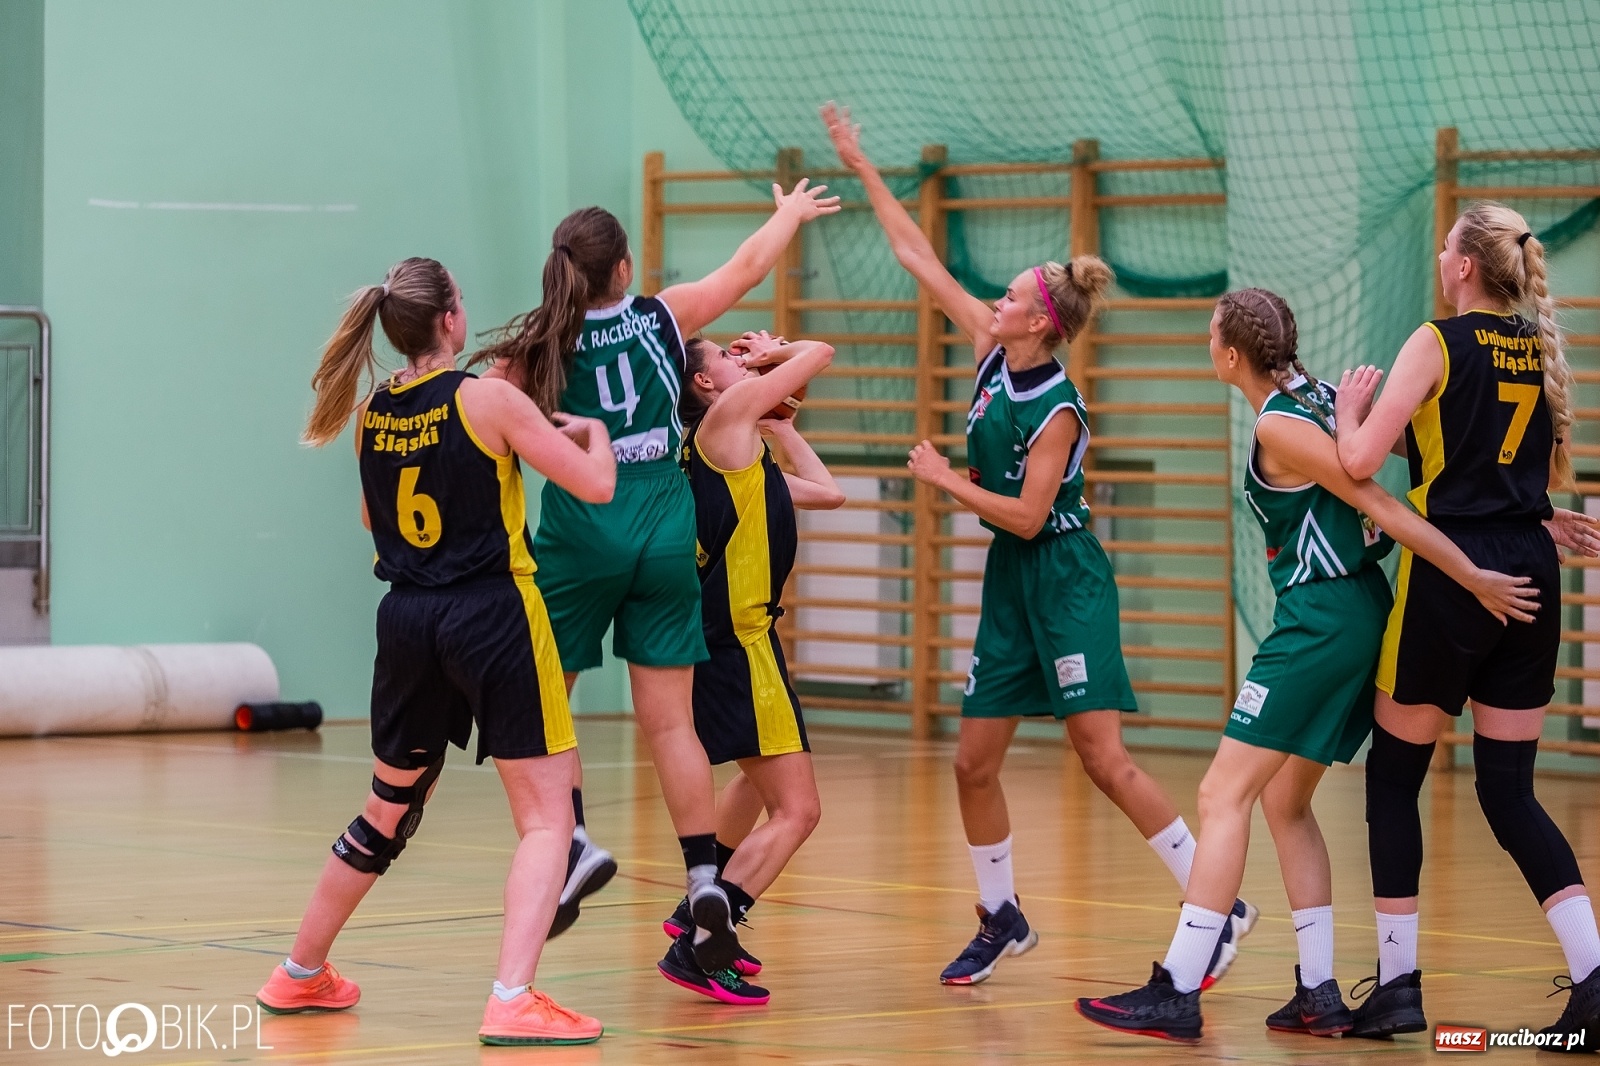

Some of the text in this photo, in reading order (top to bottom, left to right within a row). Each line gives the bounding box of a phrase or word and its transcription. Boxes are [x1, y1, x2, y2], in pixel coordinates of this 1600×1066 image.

[364, 403, 450, 432] Uniwersytet
[596, 351, 641, 428] 4
[1498, 381, 1541, 465] 7
[373, 426, 440, 456] Śląski
[397, 466, 442, 548] 6
